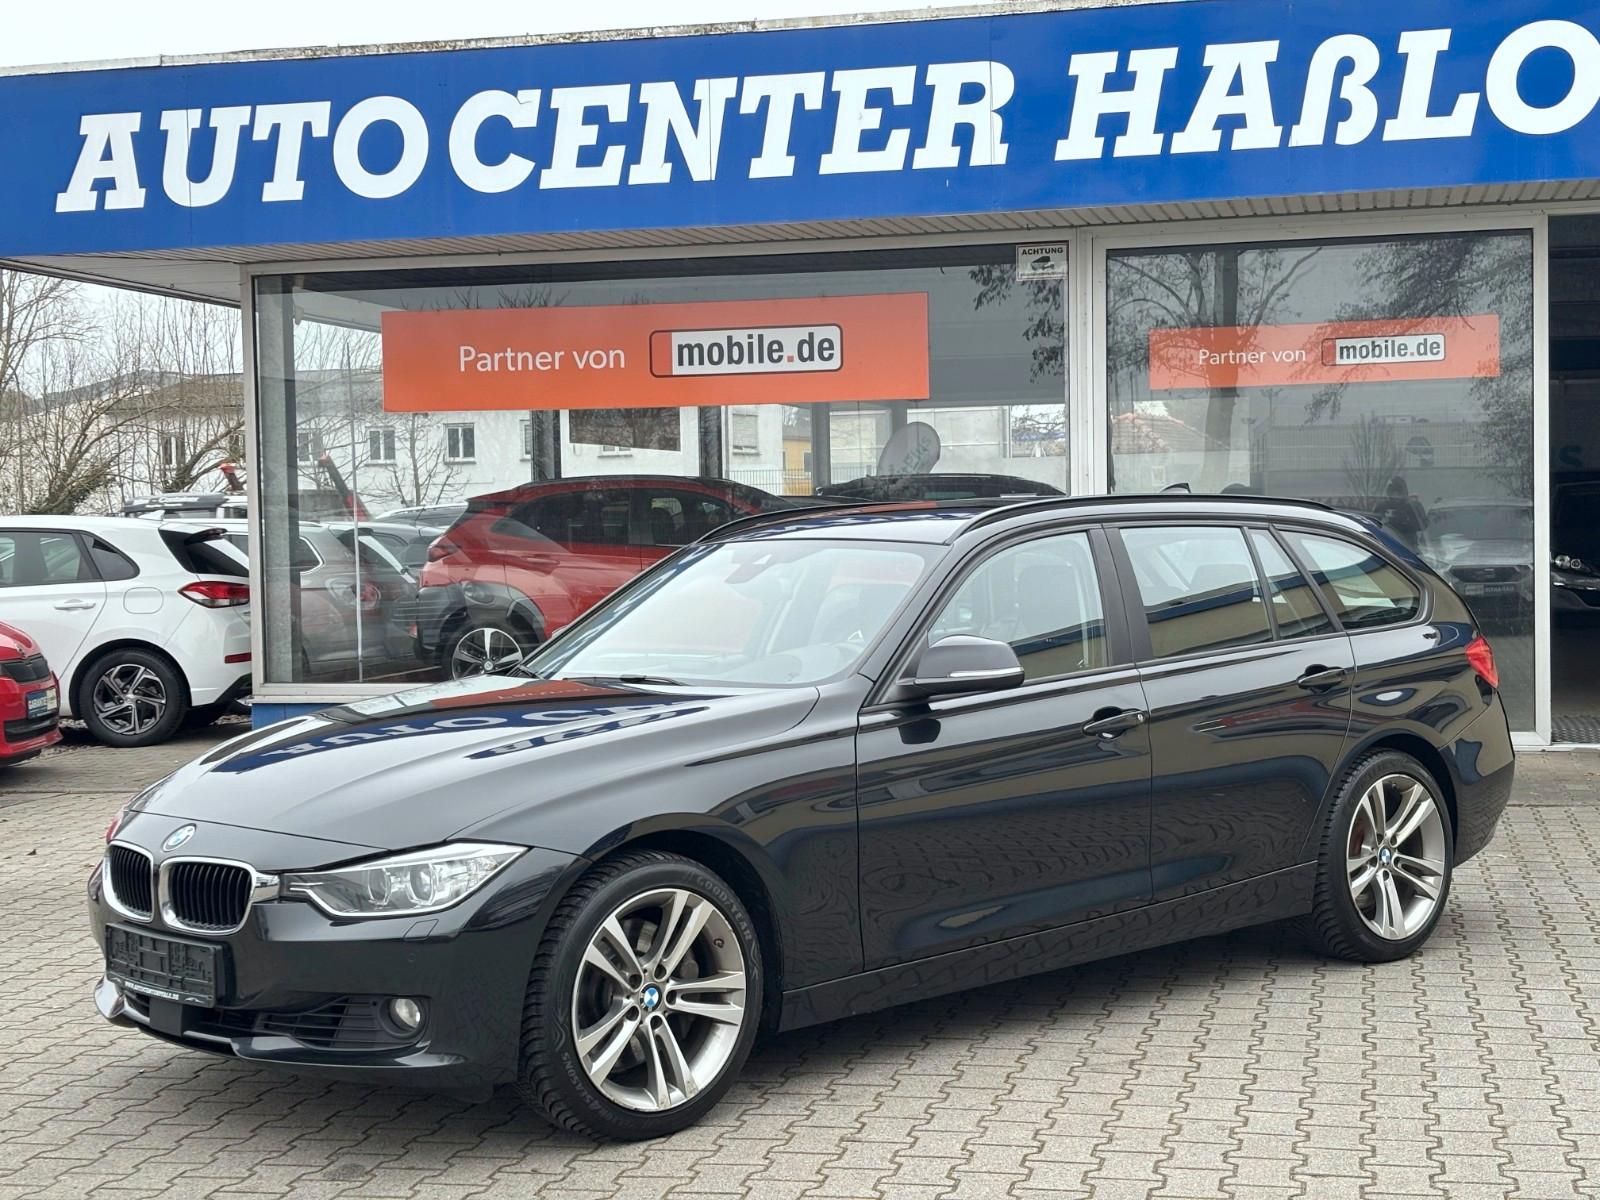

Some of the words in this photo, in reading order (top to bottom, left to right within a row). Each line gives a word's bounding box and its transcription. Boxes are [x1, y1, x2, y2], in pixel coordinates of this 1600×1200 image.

[55, 95, 429, 213] AUTO
[449, 60, 1015, 194] CENTER
[1021, 246, 1064, 256] ACHTUNG
[459, 345, 564, 373] Partner
[573, 348, 626, 370] von
[676, 331, 835, 367] mobile.de
[1198, 349, 1266, 366] Partner
[1273, 350, 1306, 363] von
[1338, 337, 1441, 360] mobile.de
